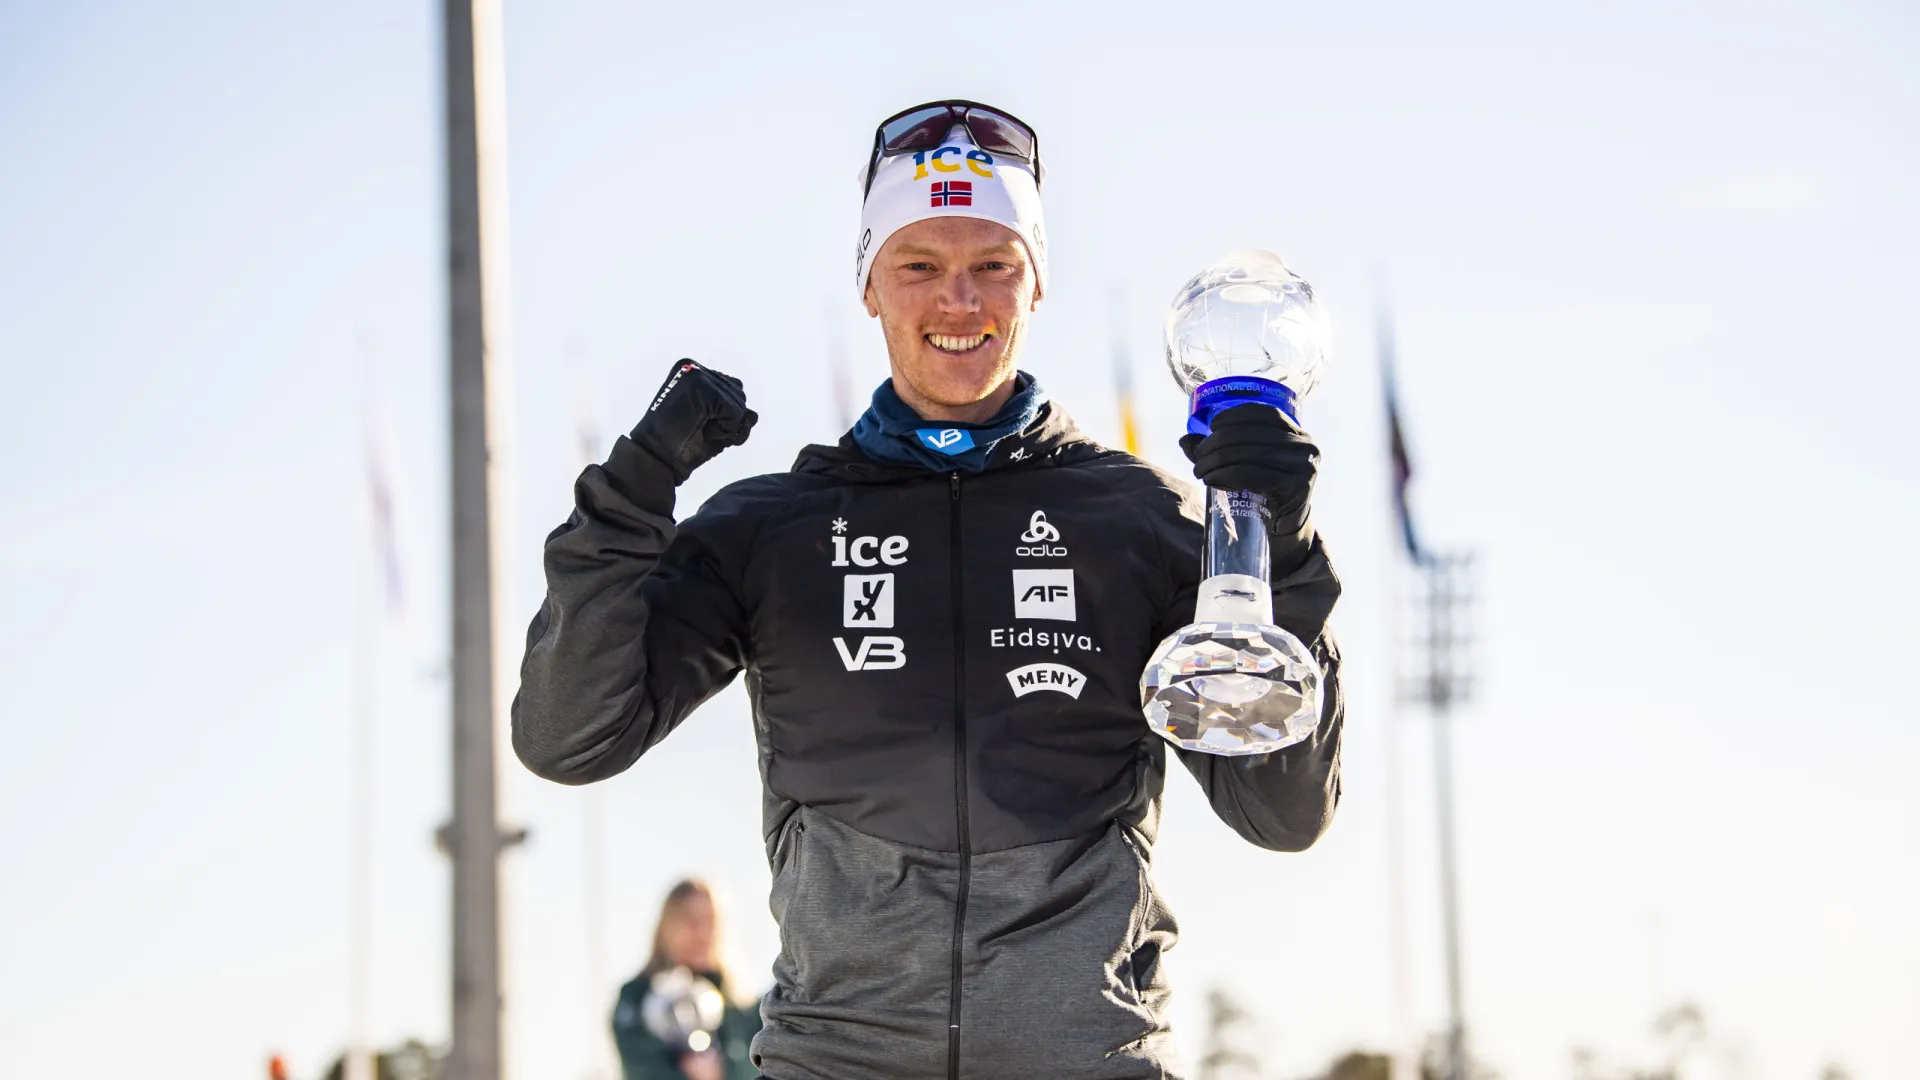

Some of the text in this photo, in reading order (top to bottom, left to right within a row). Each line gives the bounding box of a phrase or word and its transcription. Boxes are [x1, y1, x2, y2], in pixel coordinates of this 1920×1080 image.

[912, 146, 994, 182] ice
[927, 428, 963, 449] VB
[1208, 500, 1258, 514] WODCUP
[1219, 508, 1262, 519] 221/202
[831, 517, 909, 567] ice
[1015, 544, 1068, 557] odlo
[1020, 585, 1068, 603] AF
[832, 635, 907, 672] VB
[1016, 669, 1078, 688] MENY
